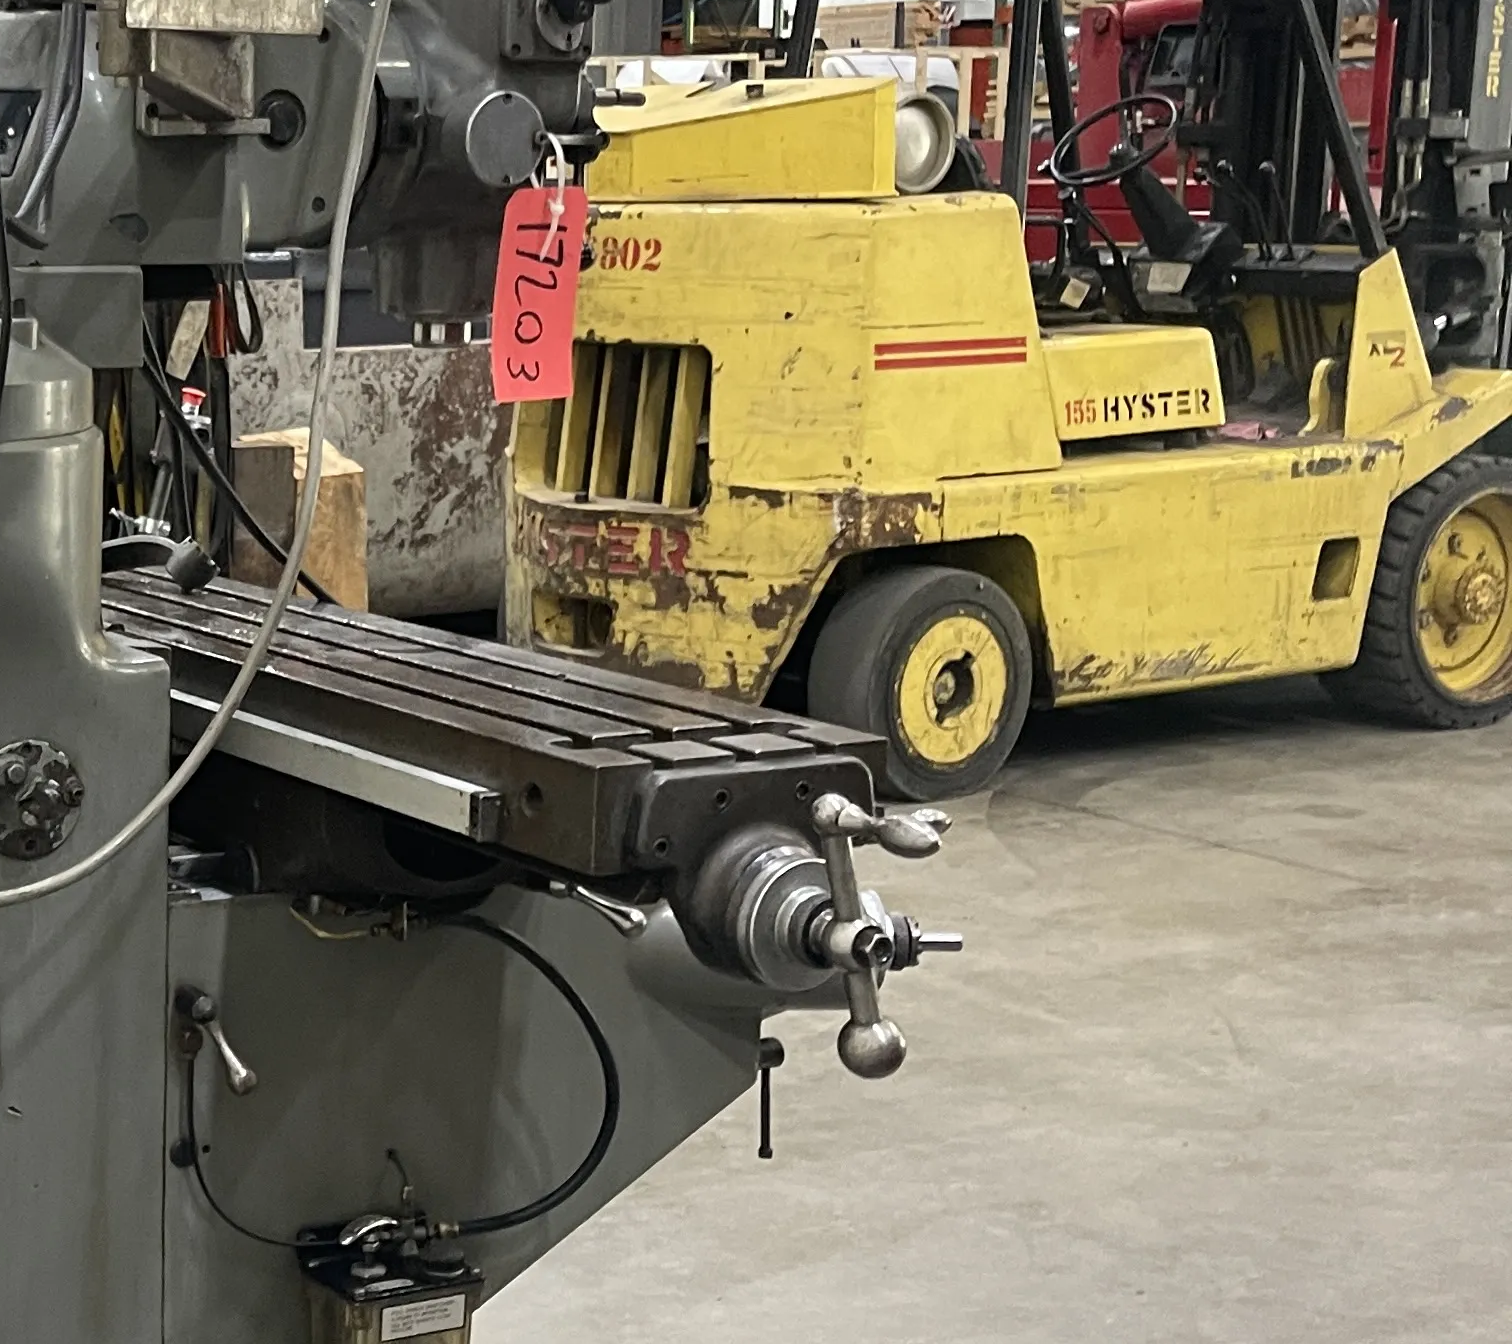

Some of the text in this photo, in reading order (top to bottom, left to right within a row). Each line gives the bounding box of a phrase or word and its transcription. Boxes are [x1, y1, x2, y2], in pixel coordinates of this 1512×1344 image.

[586, 236, 663, 272] 802
[506, 223, 568, 382] 17203
[1103, 388, 1211, 423] HYSTER
